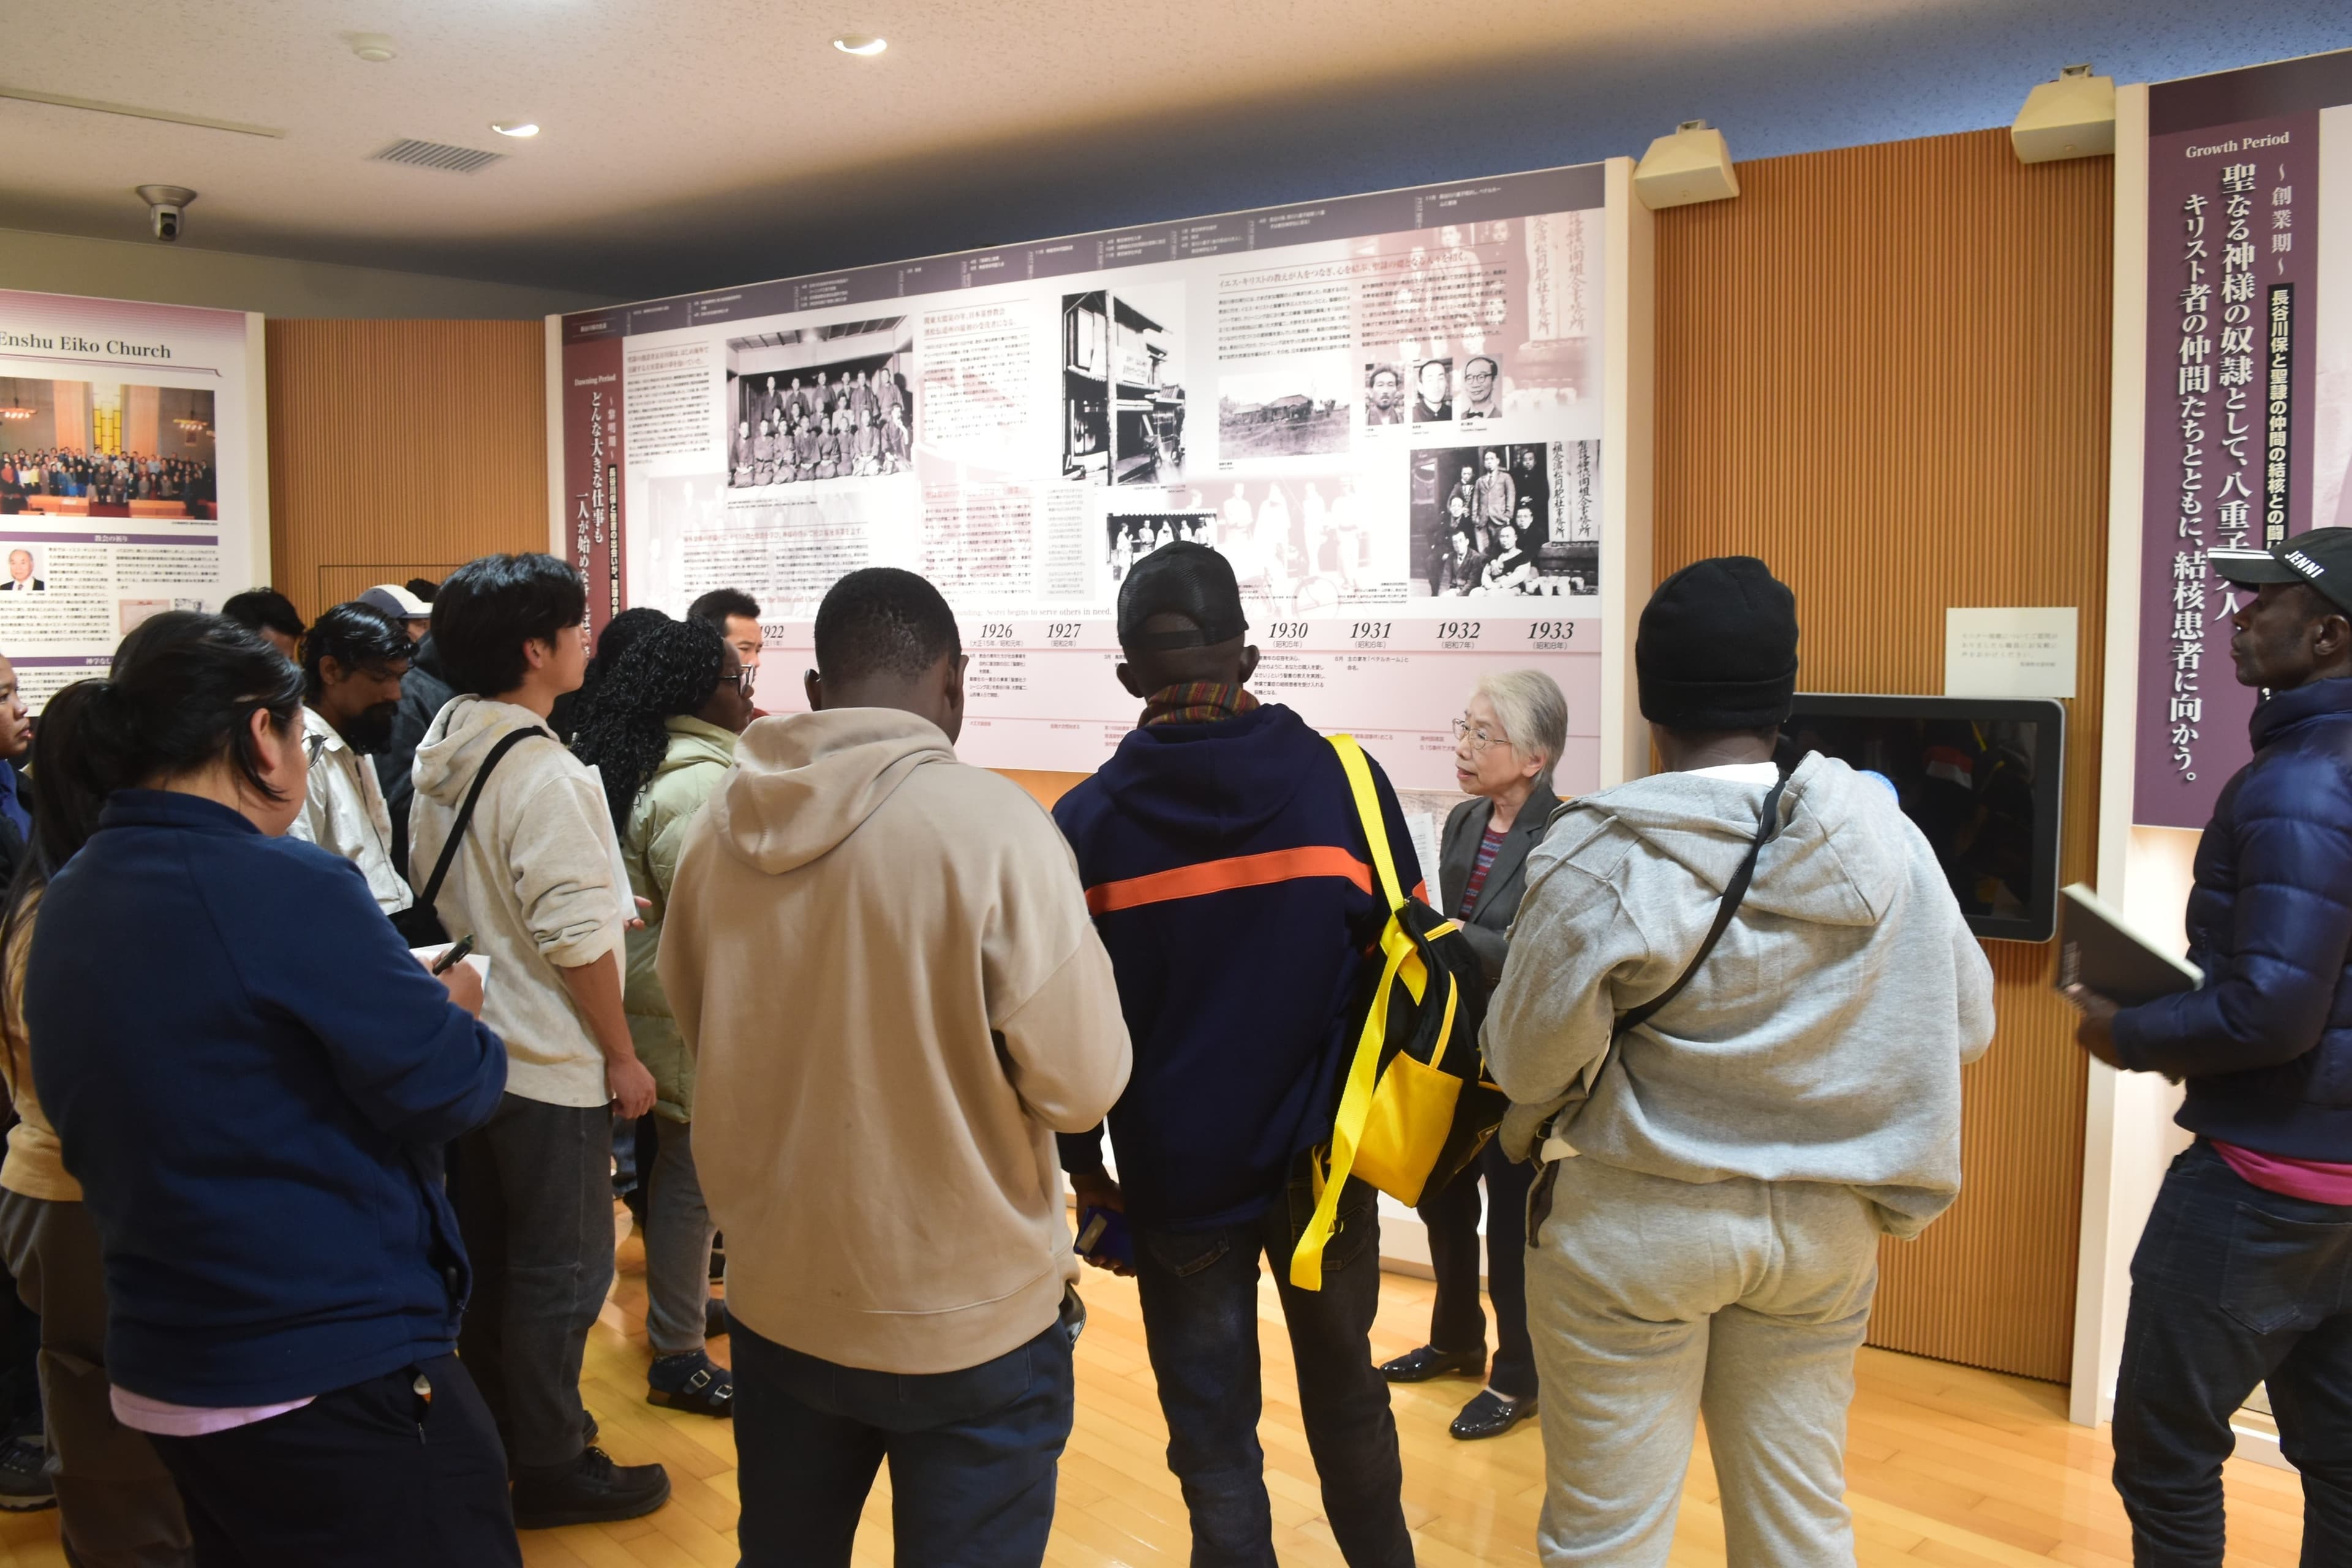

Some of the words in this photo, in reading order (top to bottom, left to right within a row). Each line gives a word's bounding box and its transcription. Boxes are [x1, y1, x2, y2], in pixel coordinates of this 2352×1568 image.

[2185, 140, 2238, 159] Growth
[2242, 132, 2290, 150] Period
[0, 331, 53, 350] Enshu
[59, 336, 100, 353] Eiko
[107, 340, 172, 359] Church
[598, 373, 616, 383] Period
[591, 392, 605, 543] どんな大きな仕事も
[2169, 194, 2212, 781] キリスト者の仲間たちとともに、結核患者に向かう。
[2285, 550, 2324, 578] JENNI
[980, 624, 1013, 638] 1926
[1047, 623, 1082, 638] 1927
[1268, 622, 1308, 638] 1930
[1349, 622, 1392, 638] 1931
[1436, 622, 1480, 639] 1932
[1528, 622, 1574, 639] 1933
